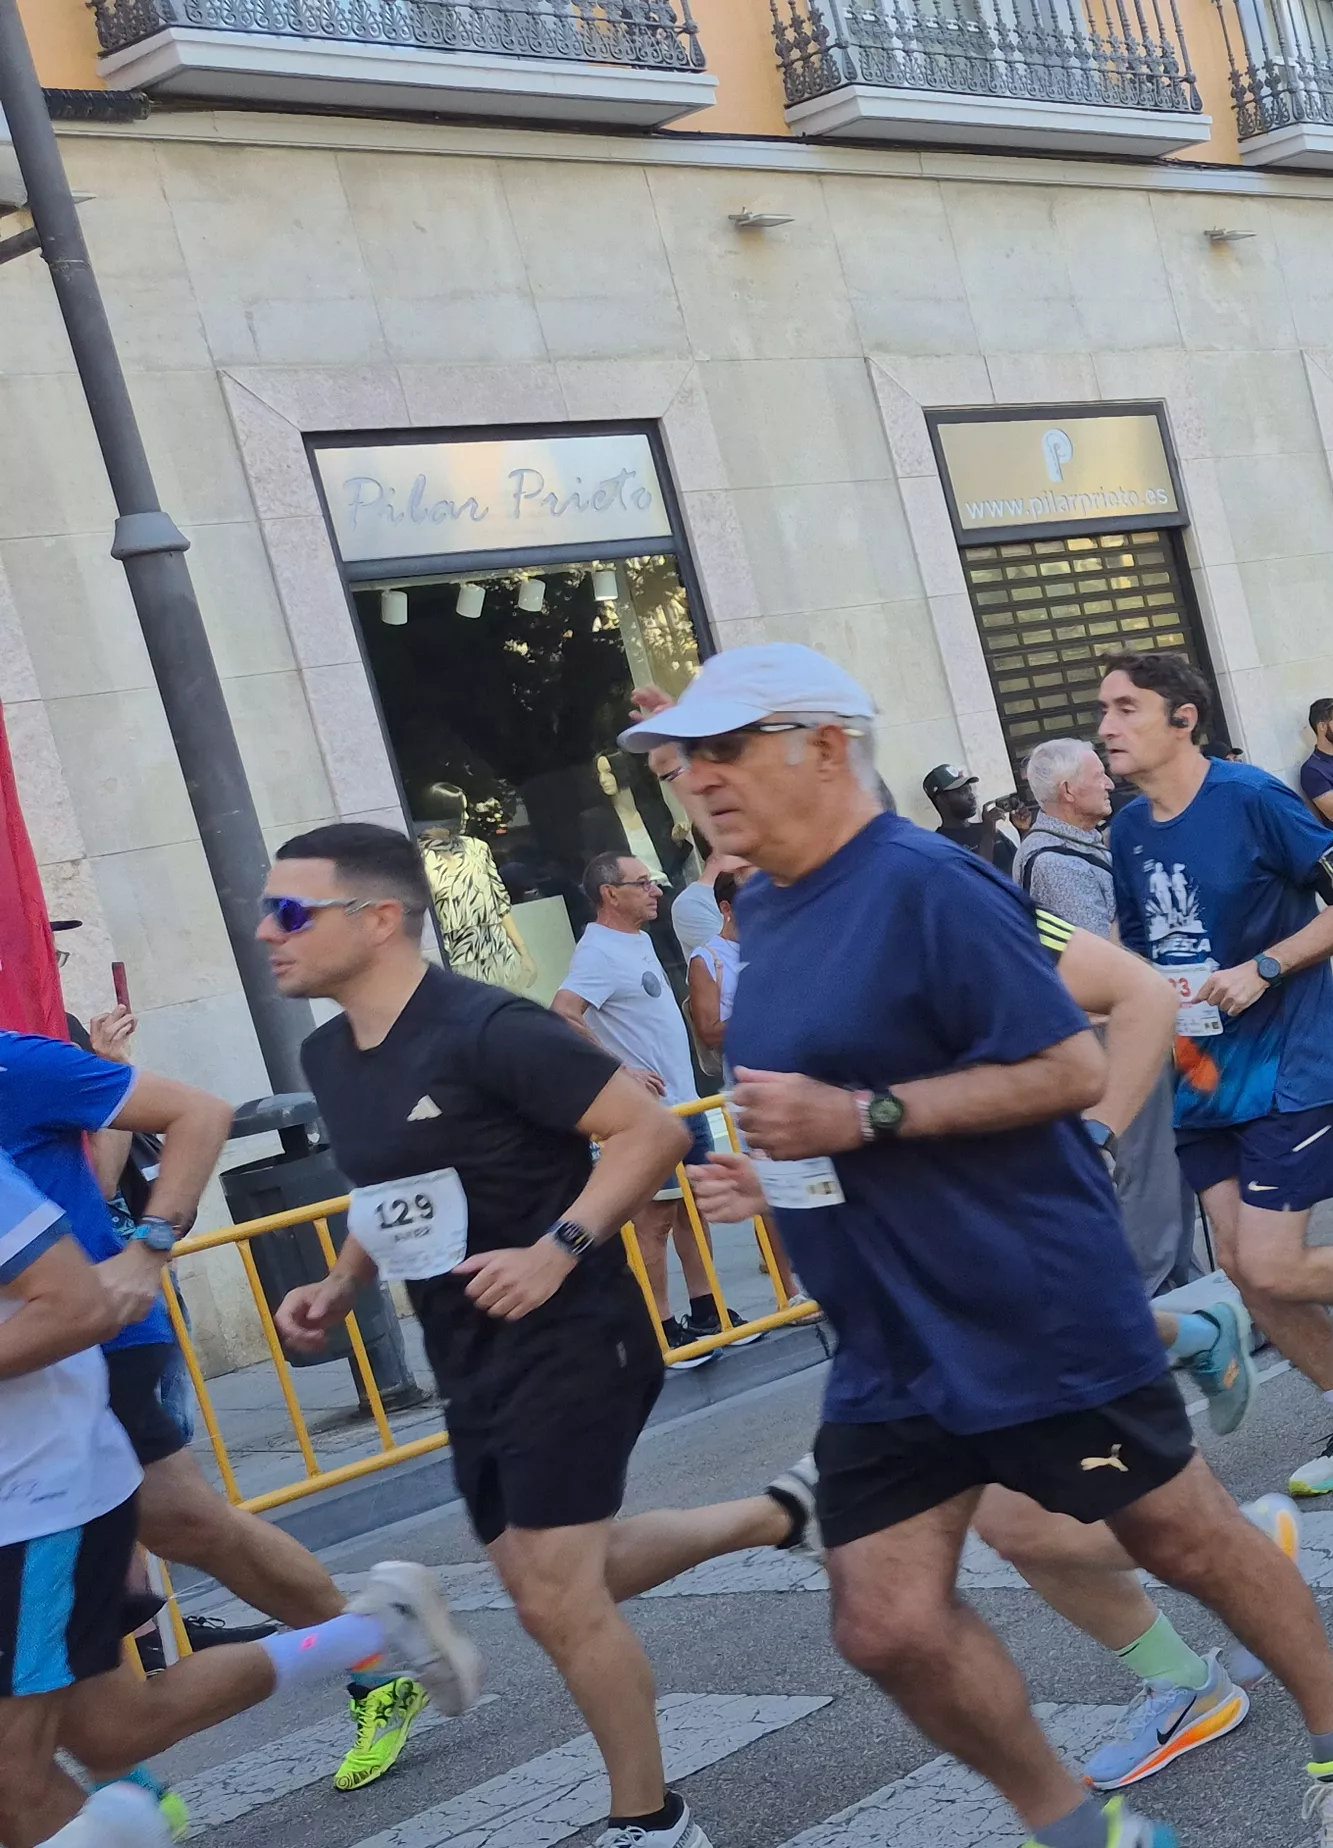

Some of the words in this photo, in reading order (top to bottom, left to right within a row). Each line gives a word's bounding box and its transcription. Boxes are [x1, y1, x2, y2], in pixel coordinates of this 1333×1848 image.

[344, 473, 489, 531] Pilar
[508, 467, 653, 519] Prieto
[965, 486, 1169, 520] www.pilarprieto.es
[374, 1193, 434, 1229] 129
